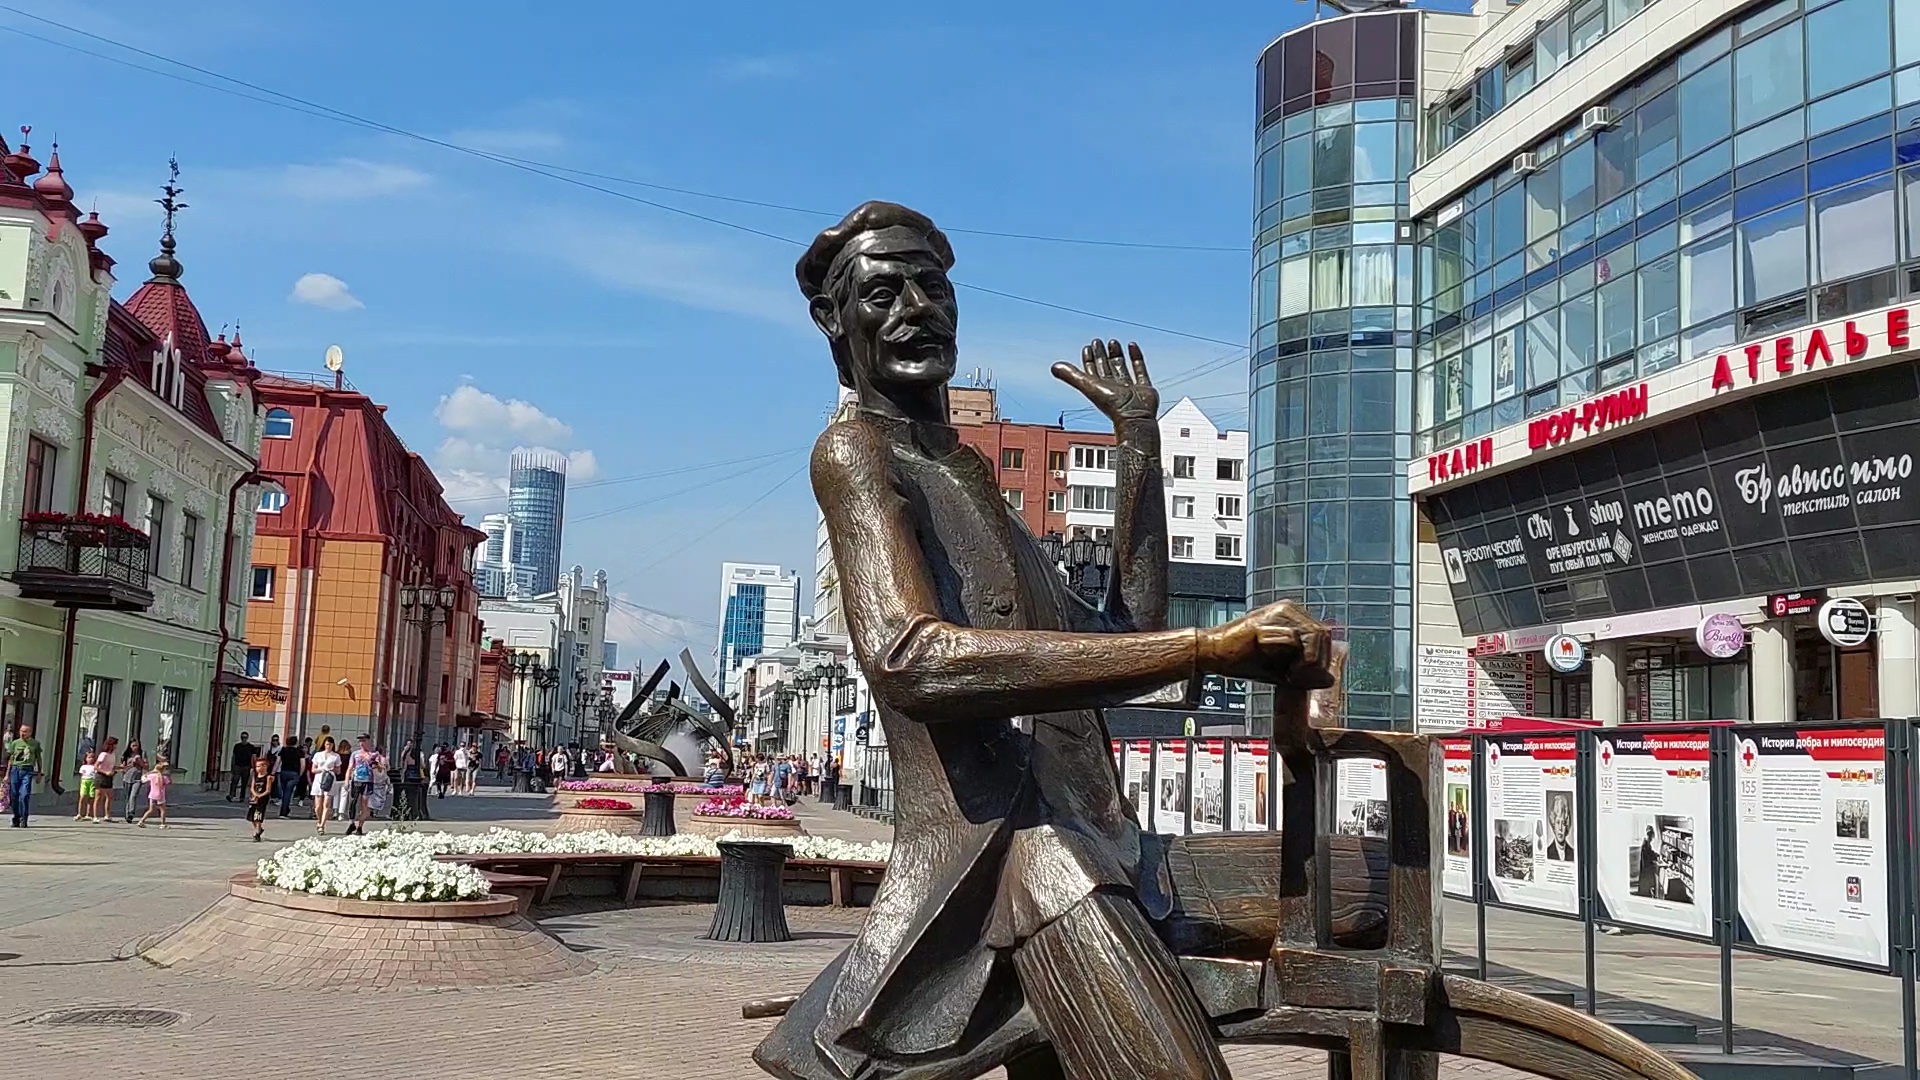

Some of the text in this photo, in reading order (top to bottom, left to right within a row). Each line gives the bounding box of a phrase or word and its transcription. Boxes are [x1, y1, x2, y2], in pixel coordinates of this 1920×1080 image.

[1711, 308, 1910, 391] АТЕЛЬЕ
[1528, 383, 1648, 449] ШОУ-РУМЫ
[1428, 437, 1493, 482] ТКАНИ
[1734, 453, 1913, 514] Брависсимо
[1633, 487, 1714, 529] memo
[1783, 485, 1901, 517] текстиль салон
[1527, 500, 1624, 541] City shop
[1642, 519, 1719, 544] женская одежда
[1462, 534, 1524, 564] ЭКЗОТИЧЕСКИЙ
[1495, 553, 1528, 569] ТРИКОТАЖ
[1546, 532, 1612, 561] ОРЕНБУРГСКИЙ
[1502, 741, 1523, 752] История
[1523, 741, 1539, 751] добра
[1616, 739, 1710, 751] История добра и милосердия
[1761, 736, 1885, 750] История добра и милосердия
[1741, 780, 1757, 794] 155
